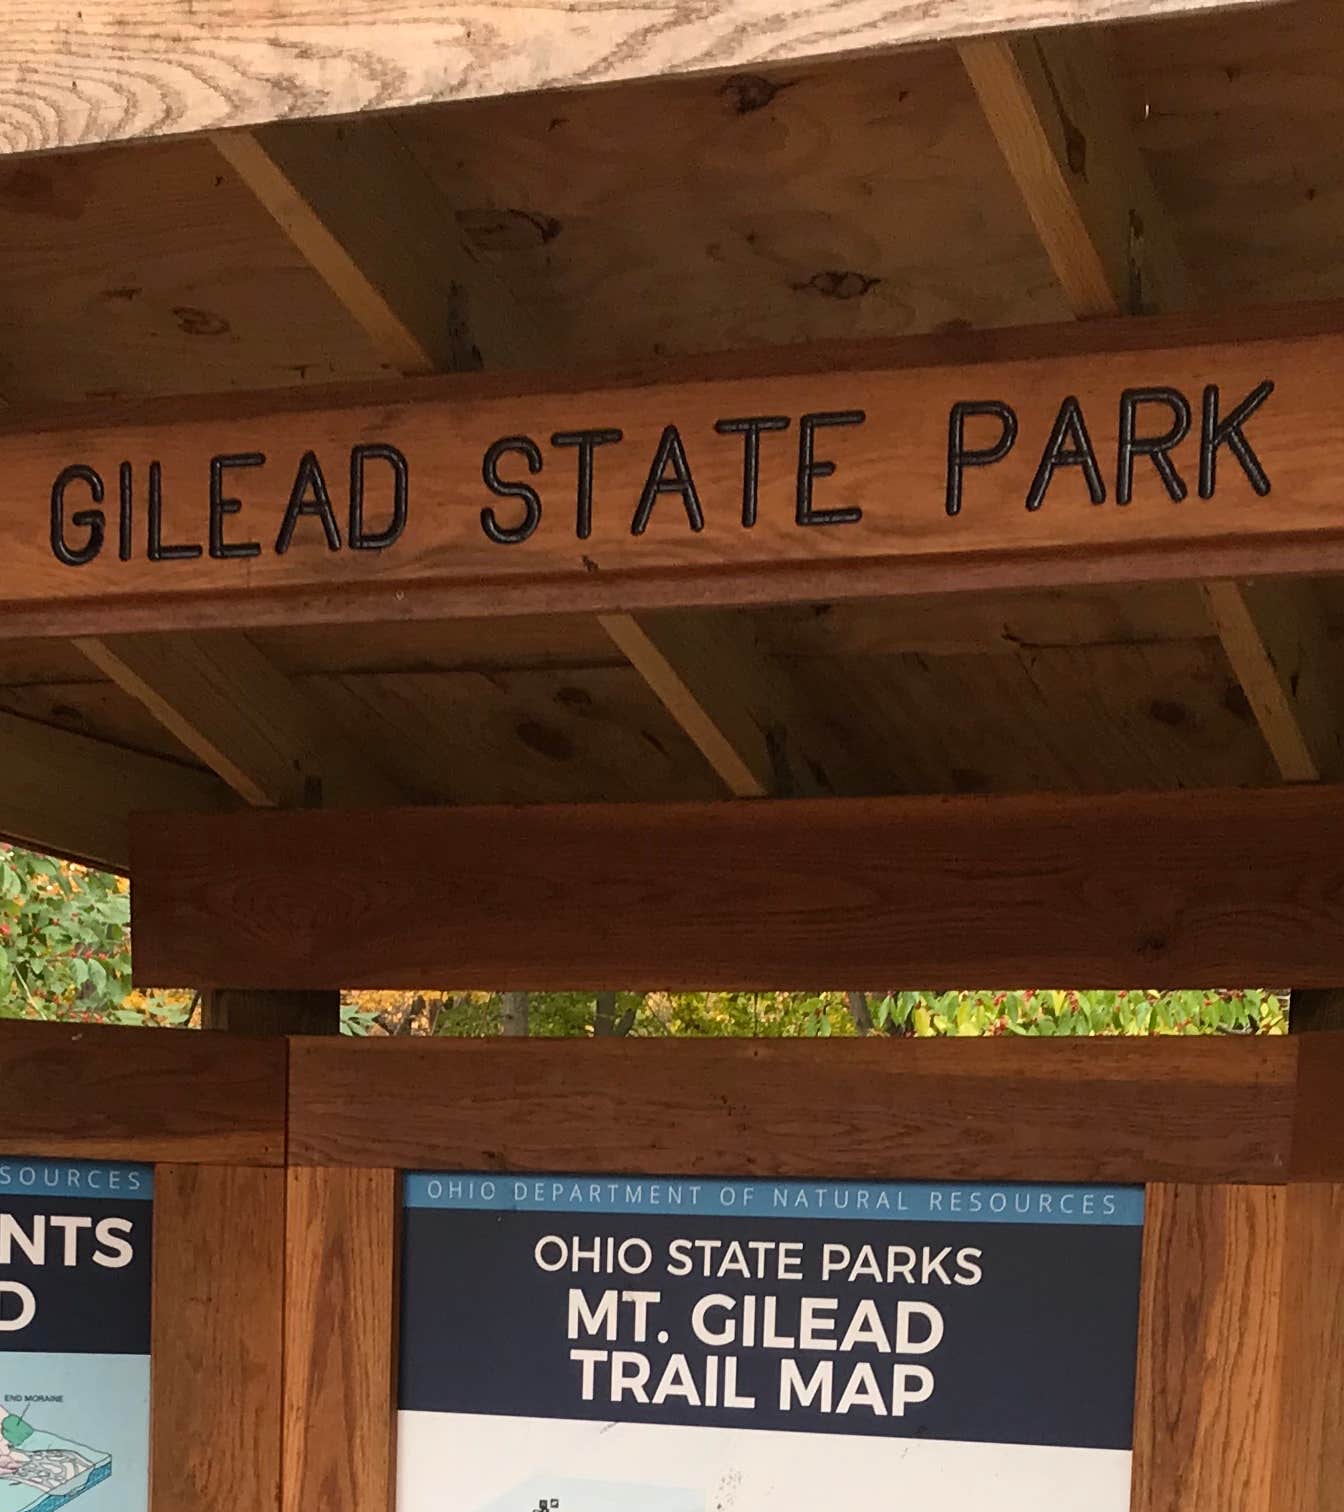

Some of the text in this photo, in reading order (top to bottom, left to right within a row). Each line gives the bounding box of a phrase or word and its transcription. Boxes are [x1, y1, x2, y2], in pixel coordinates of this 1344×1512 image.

[50, 443, 409, 566] GILEAD
[480, 410, 866, 544] STATE
[945, 380, 1276, 516] PARK
[427, 1180, 1115, 1216] OHIO DEPARTMENT OF NATURAL RESOURCES
[534, 1235, 982, 1286] OHIO STATE PARKS
[567, 1288, 944, 1354] MT. GILEAD
[569, 1348, 934, 1417] TRAIL MAP
